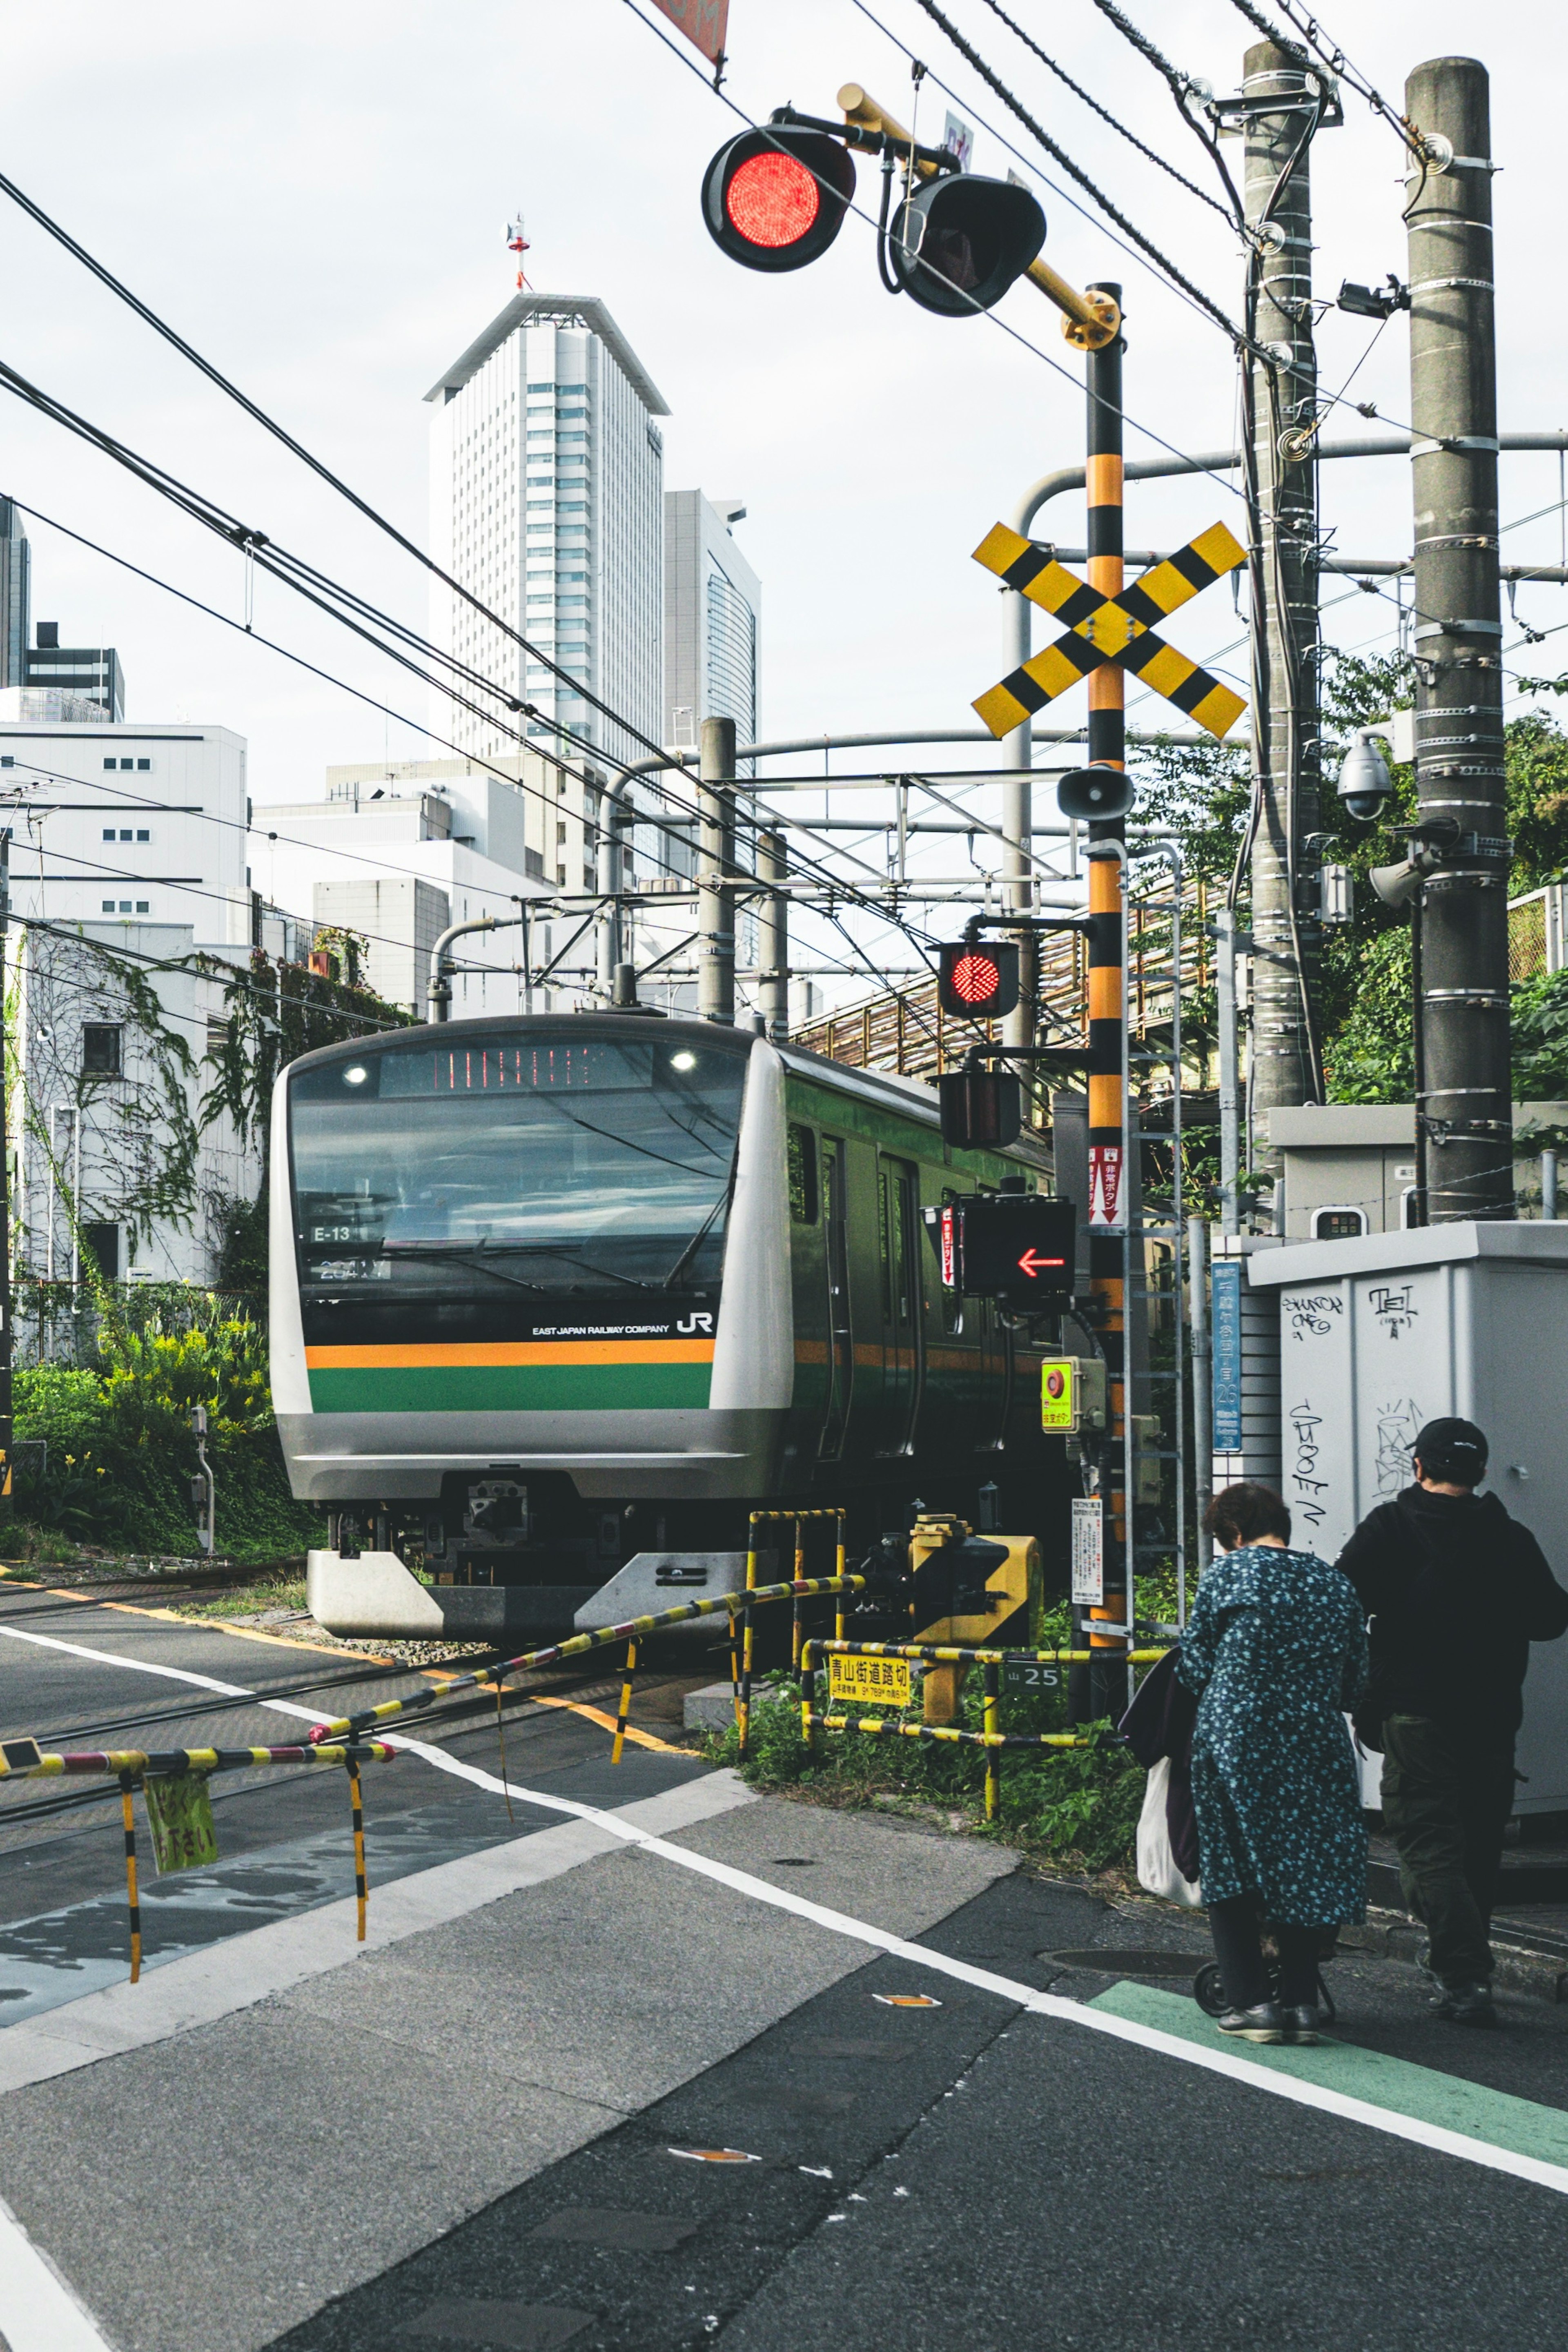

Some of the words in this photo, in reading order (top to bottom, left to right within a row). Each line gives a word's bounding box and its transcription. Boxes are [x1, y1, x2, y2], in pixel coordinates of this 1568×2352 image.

[1105, 1165, 1116, 1209] 非常ボタン
[315, 1227, 350, 1241] E-13
[556, 1327, 586, 1335] JAPAN
[588, 1326, 624, 1334] RAILWAY
[625, 1325, 670, 1333] COMPANY
[677, 1312, 713, 1333] JR
[1216, 1384, 1237, 1404] 26
[832, 1659, 906, 1686] 青山街道踏切
[1009, 1672, 1020, 1680] 山
[1025, 1668, 1058, 1686] 25
